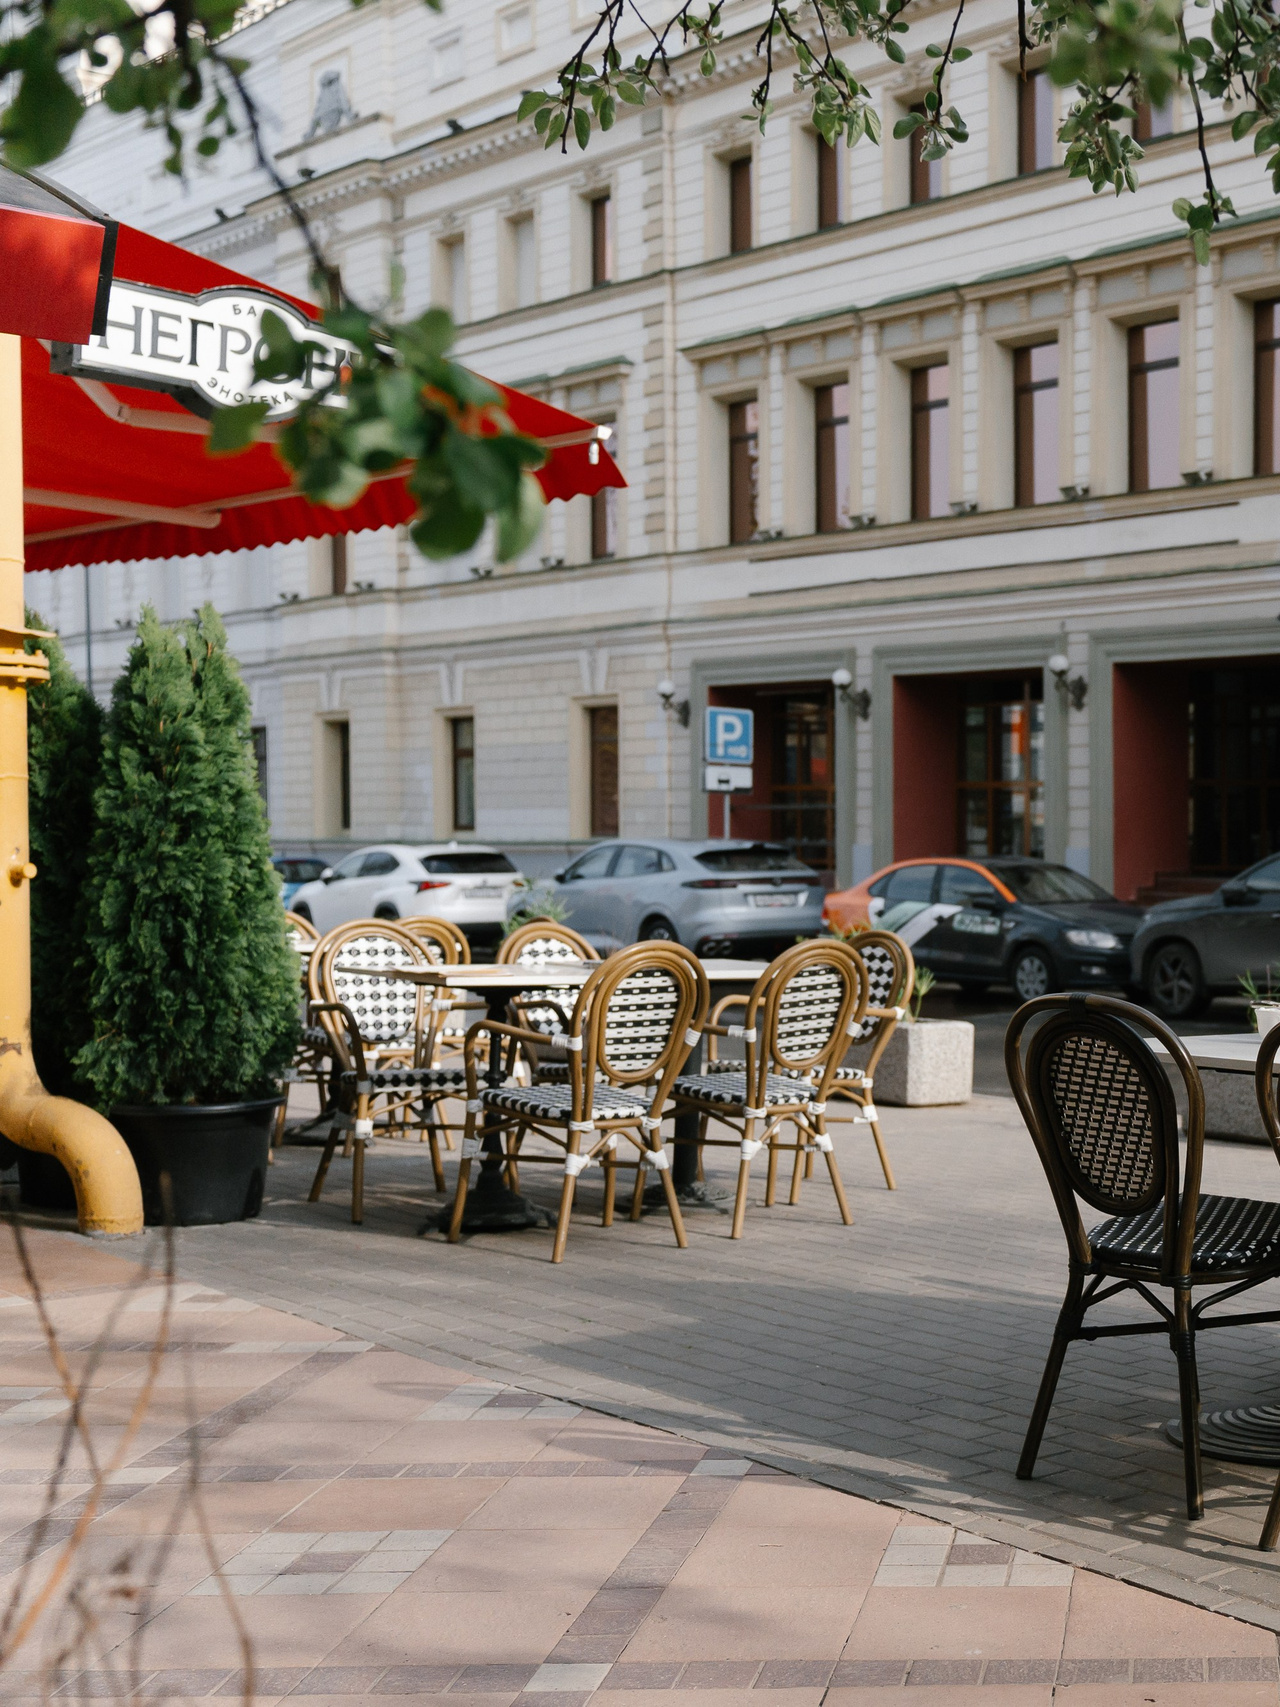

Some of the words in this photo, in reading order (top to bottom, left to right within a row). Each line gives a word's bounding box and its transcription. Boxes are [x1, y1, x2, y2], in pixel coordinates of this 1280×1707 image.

[232, 303, 257, 317] БА
[206, 376, 294, 407] ЭНОТЕКА
[716, 714, 743, 757] P
